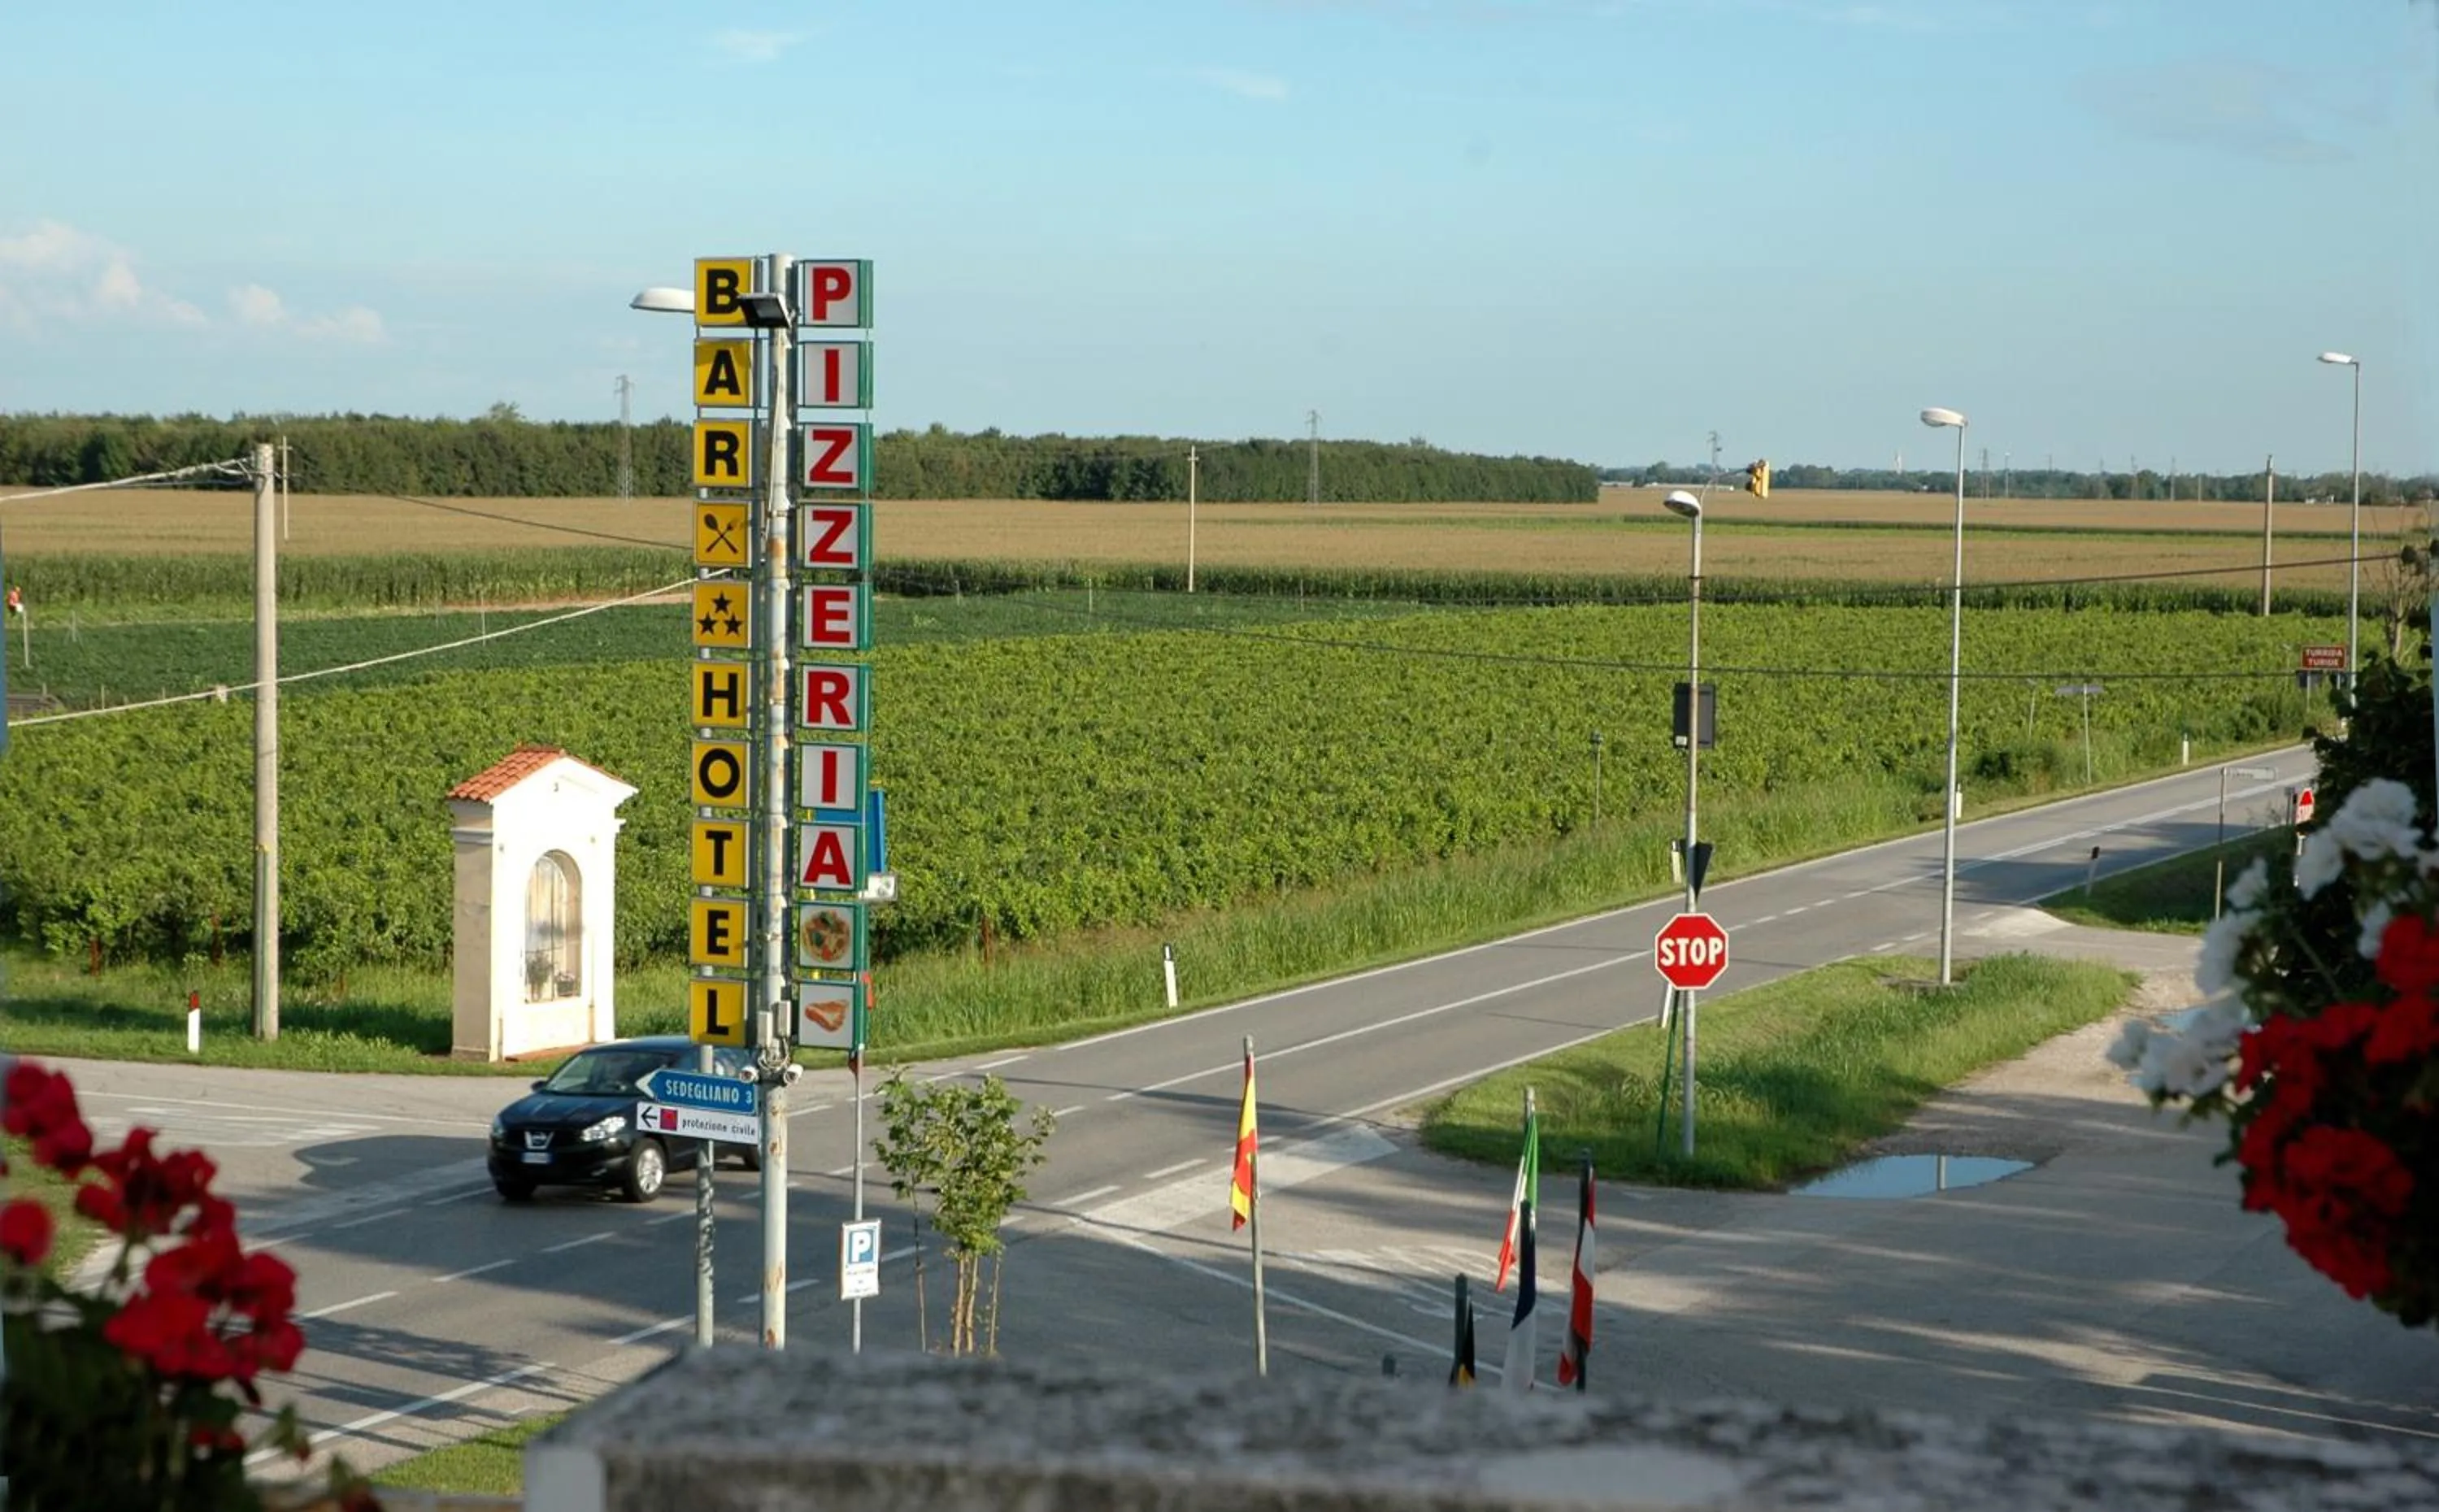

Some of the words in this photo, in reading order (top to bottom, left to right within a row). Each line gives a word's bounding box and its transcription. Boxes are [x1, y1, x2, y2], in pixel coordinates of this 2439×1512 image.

[704, 268, 741, 476] BAR
[803, 267, 854, 885] PIZZERIA
[699, 671, 740, 1036] HOTEL
[1660, 936, 1724, 967] STOP
[665, 1079, 740, 1105] SEDEGLIANO
[745, 1090, 753, 1105] 3
[682, 1118, 728, 1132] protezione
[731, 1124, 755, 1136] civile
[850, 1231, 872, 1262] P
